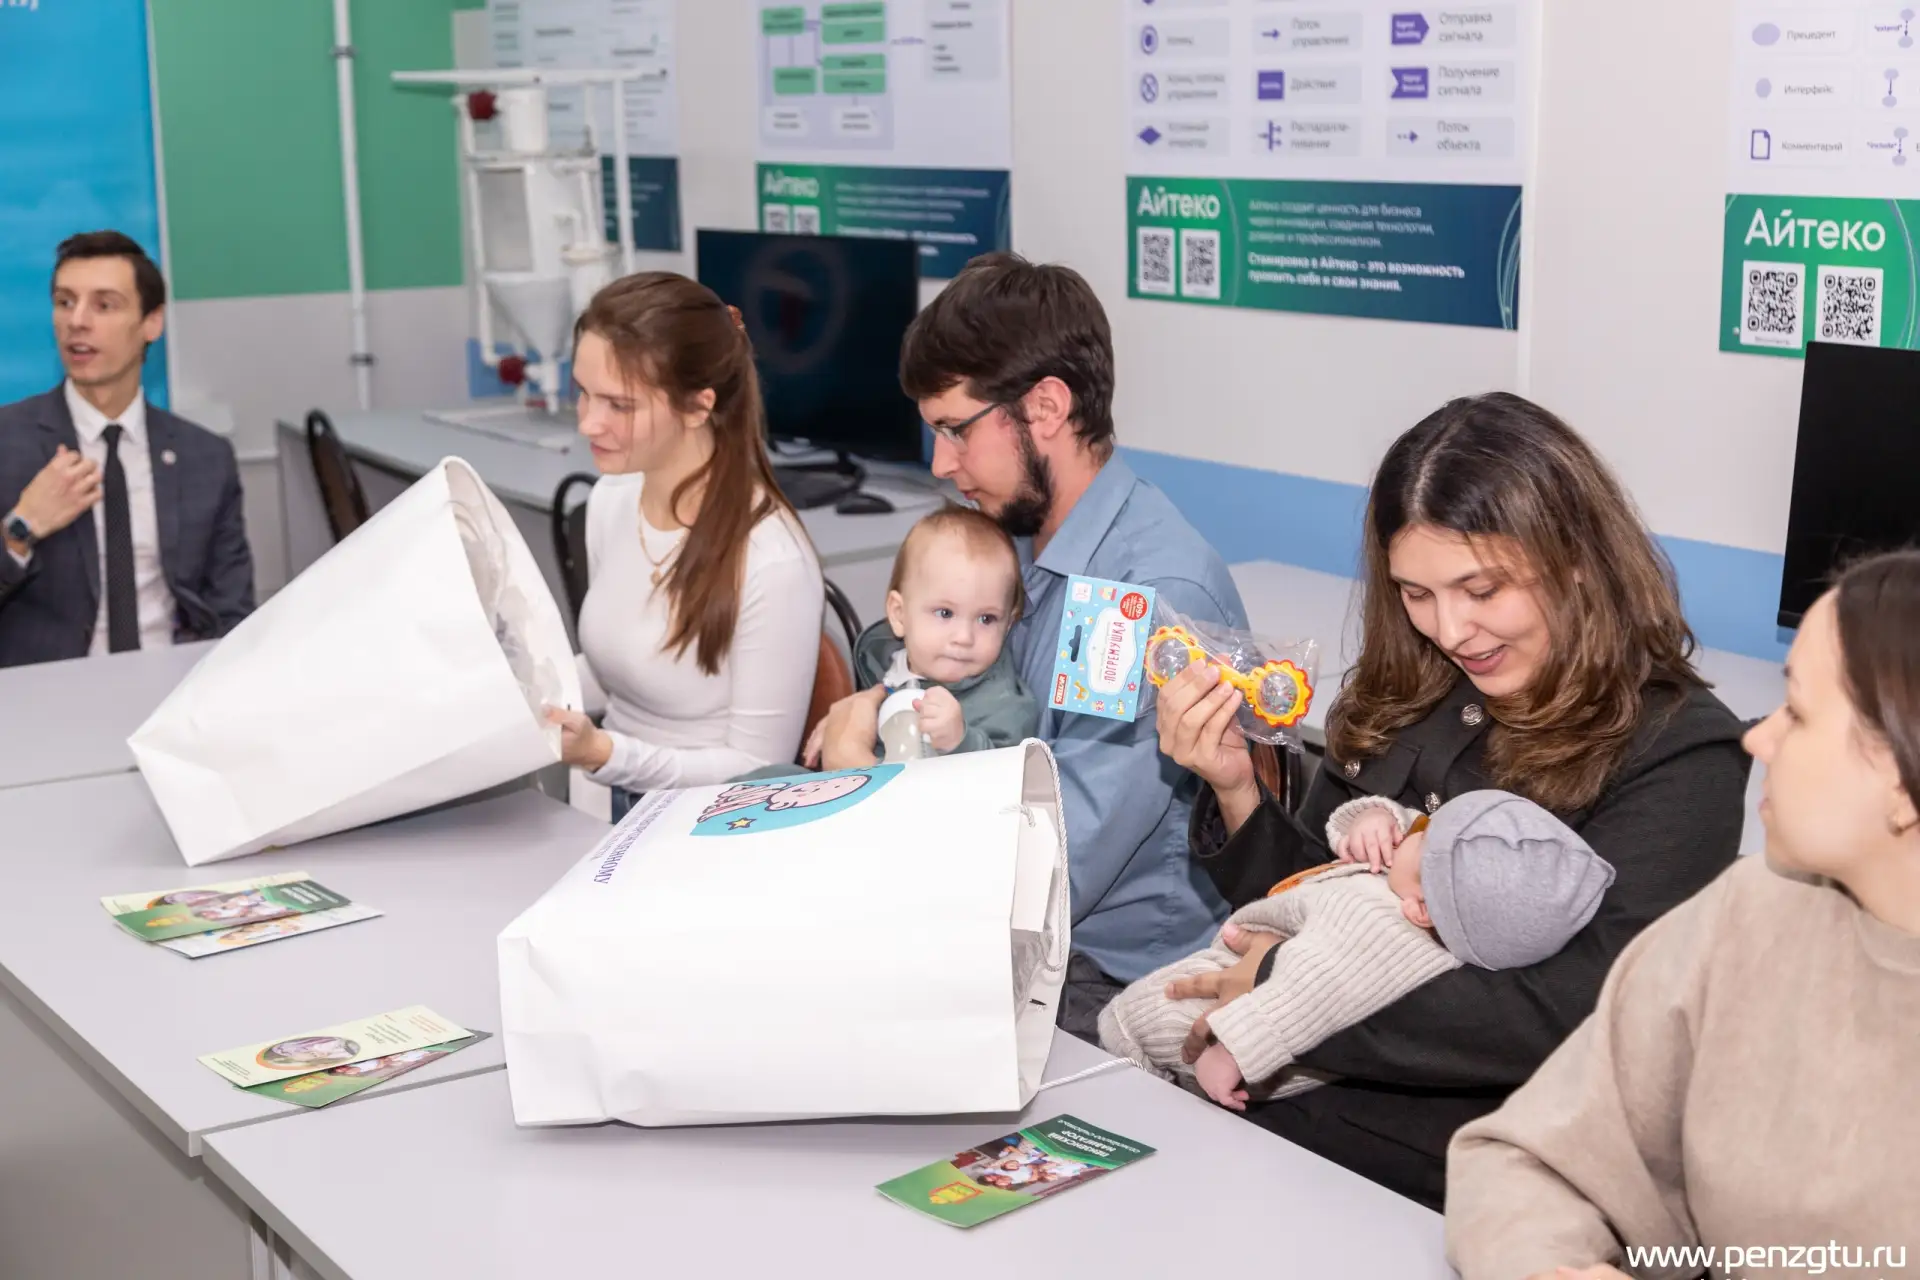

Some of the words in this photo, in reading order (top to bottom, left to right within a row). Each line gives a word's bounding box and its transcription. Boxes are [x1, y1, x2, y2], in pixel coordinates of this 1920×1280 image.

[1136, 185, 1221, 219] Айтеко
[1744, 207, 1887, 252] Айтеко
[1103, 620, 1127, 682] ПОГРЕМУШКА
